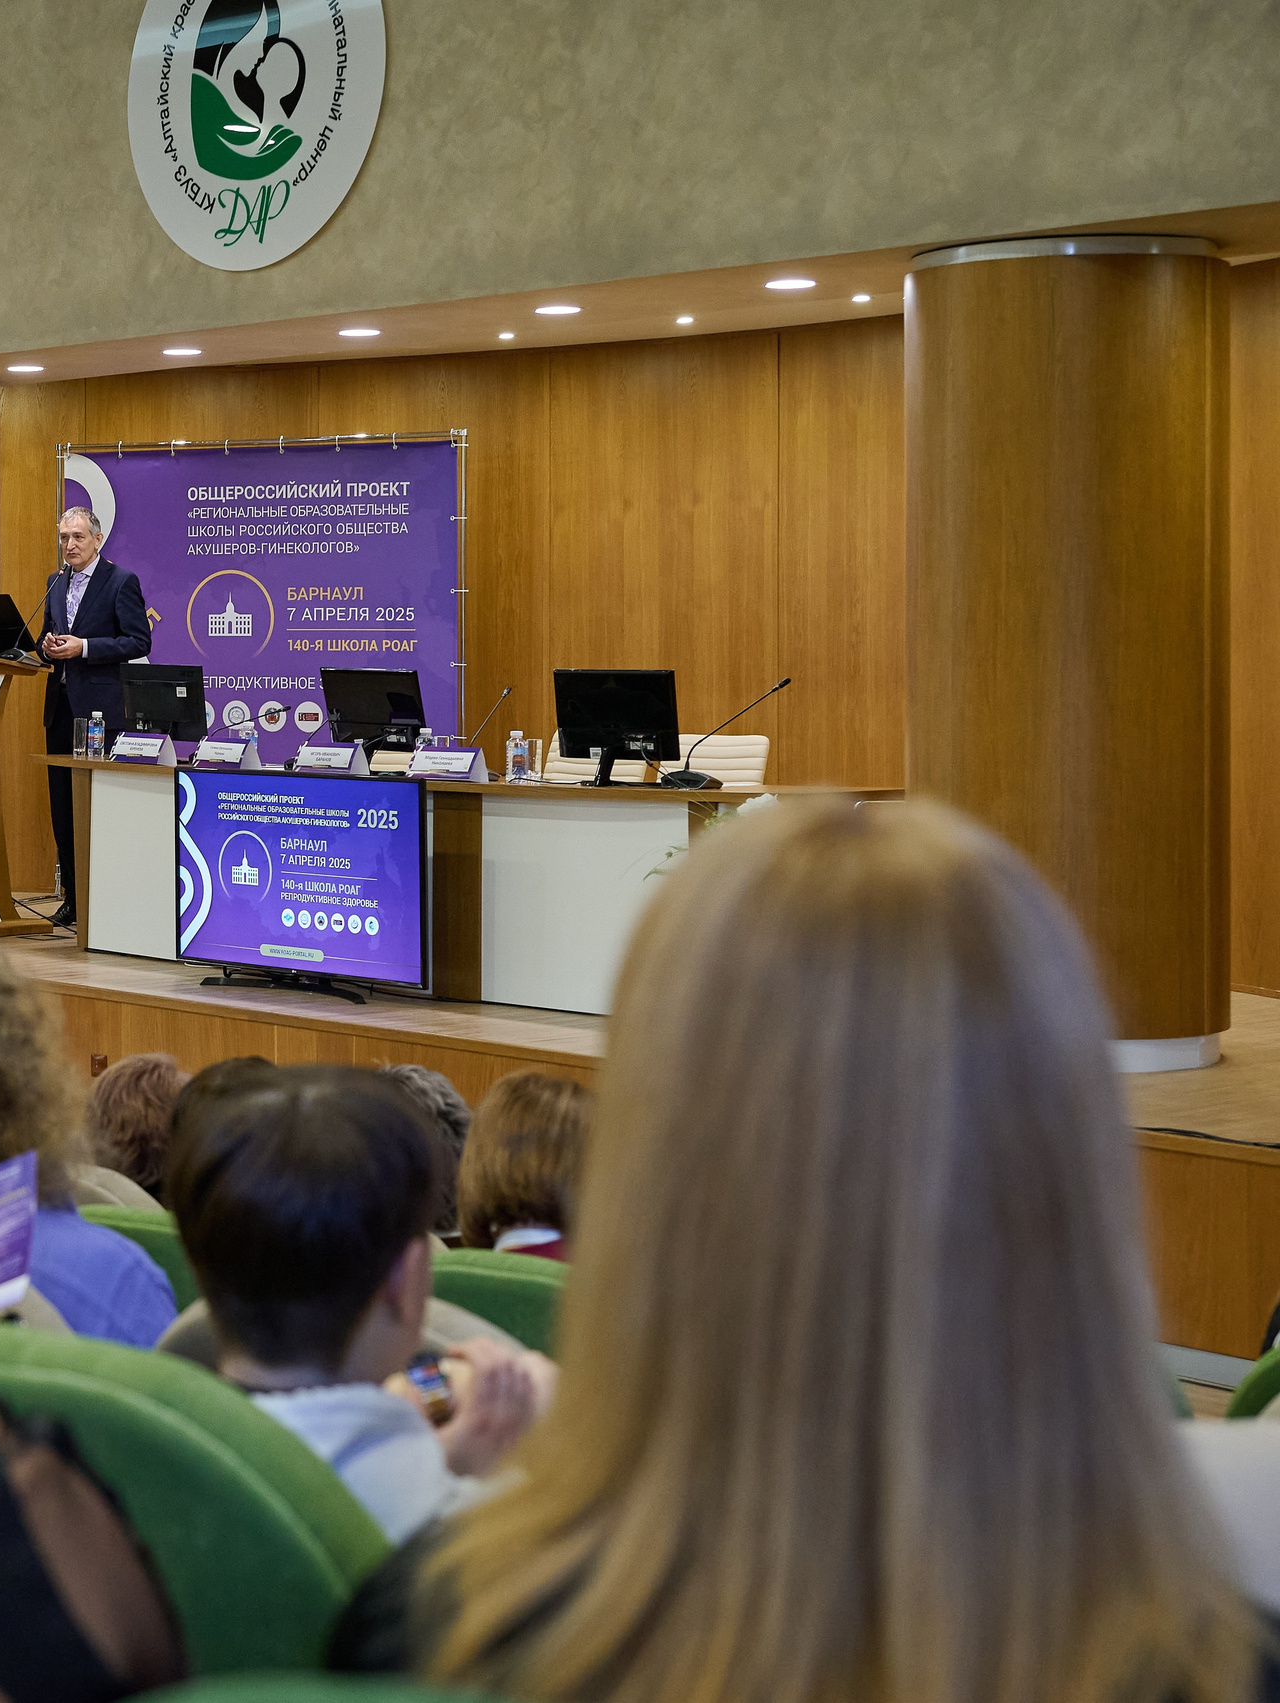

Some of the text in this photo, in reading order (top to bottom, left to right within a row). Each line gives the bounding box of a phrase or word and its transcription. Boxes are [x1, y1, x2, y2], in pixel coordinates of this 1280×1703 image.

[156, 43, 179, 163] «Алтайский
[292, 125, 334, 187] центр»
[173, 164, 217, 214] КГБУЗ
[214, 179, 291, 247] ДАР
[187, 480, 411, 502] ОБЩЕРОССИЙСКИЙ ПРОЕКТ
[187, 503, 410, 519] «РЕГИОНАЛЬНЫЕ ОБРАЗОВАТЕЛЬНЫЕ
[187, 521, 409, 537] ШКОЛЫ РОССИЙСКОГО ОБЩЕСТВА
[186, 541, 360, 555] АКУШЕРОВ-ГИНЕКОЛОГОВ»
[287, 587, 364, 600] БАРНАУЛ
[286, 607, 415, 621] 7 АПРЕЛЯ 2025
[287, 639, 418, 651] 140-Я ШКОЛА РОАГ
[203, 676, 316, 691] ЕПРОДУКТИВНОЕ
[218, 792, 304, 804] ОБЩЕРОССИЙСКИЙ ПРОЕКТ
[218, 803, 349, 818] «РЕГИОНАЛЬНЫЕ ОБРАЗОВАТЕЛЬНЫЕ ШКОЛЫ
[218, 812, 253, 822] РОССИЙСКОГО
[253, 814, 280, 824] ОБЩЕСТВА
[357, 808, 399, 830] 2025
[280, 838, 327, 852] БАРНАУЛ
[280, 854, 351, 870] 7 АПРЕЛЯ 2025
[281, 879, 361, 895] 140-я ШКОЛА РОАГ
[280, 892, 379, 909] РЕПРОДУКТИВНОЕ ЗДОРОВЬЕ
